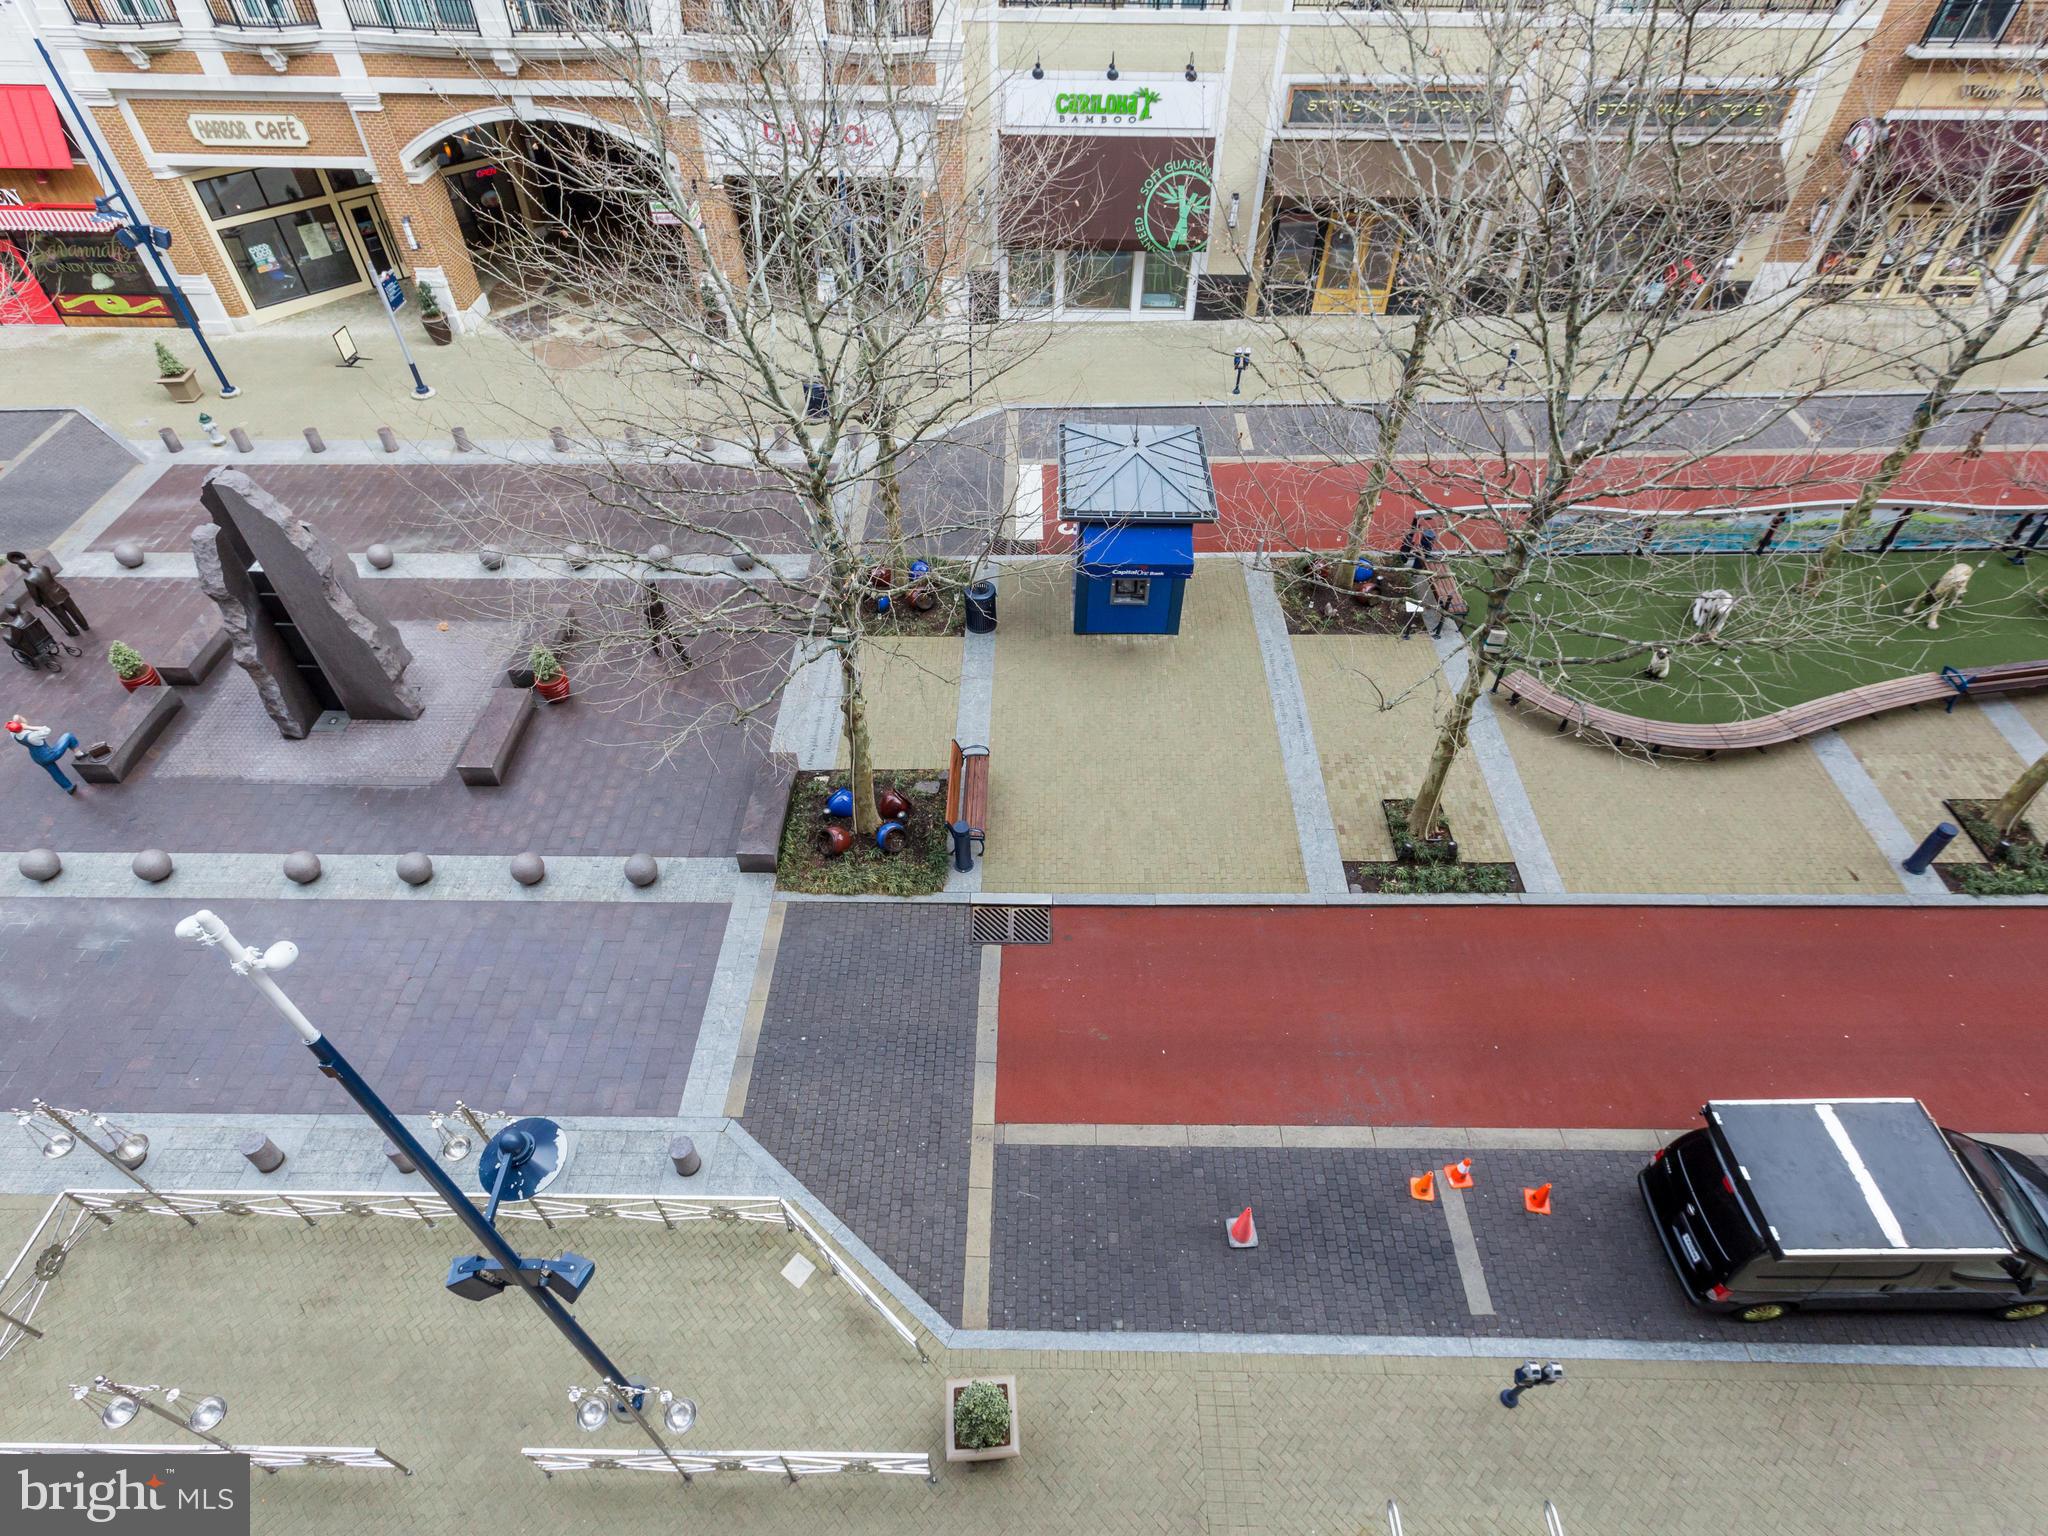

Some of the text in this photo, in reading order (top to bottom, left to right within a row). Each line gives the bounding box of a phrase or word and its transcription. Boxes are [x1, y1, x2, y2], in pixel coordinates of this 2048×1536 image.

[195, 116, 302, 140] HARBOR CAFÉ
[1059, 115, 1137, 123] BAMBOO
[1140, 168, 1162, 196] SOFT
[87, 262, 137, 274] KITCHEN
